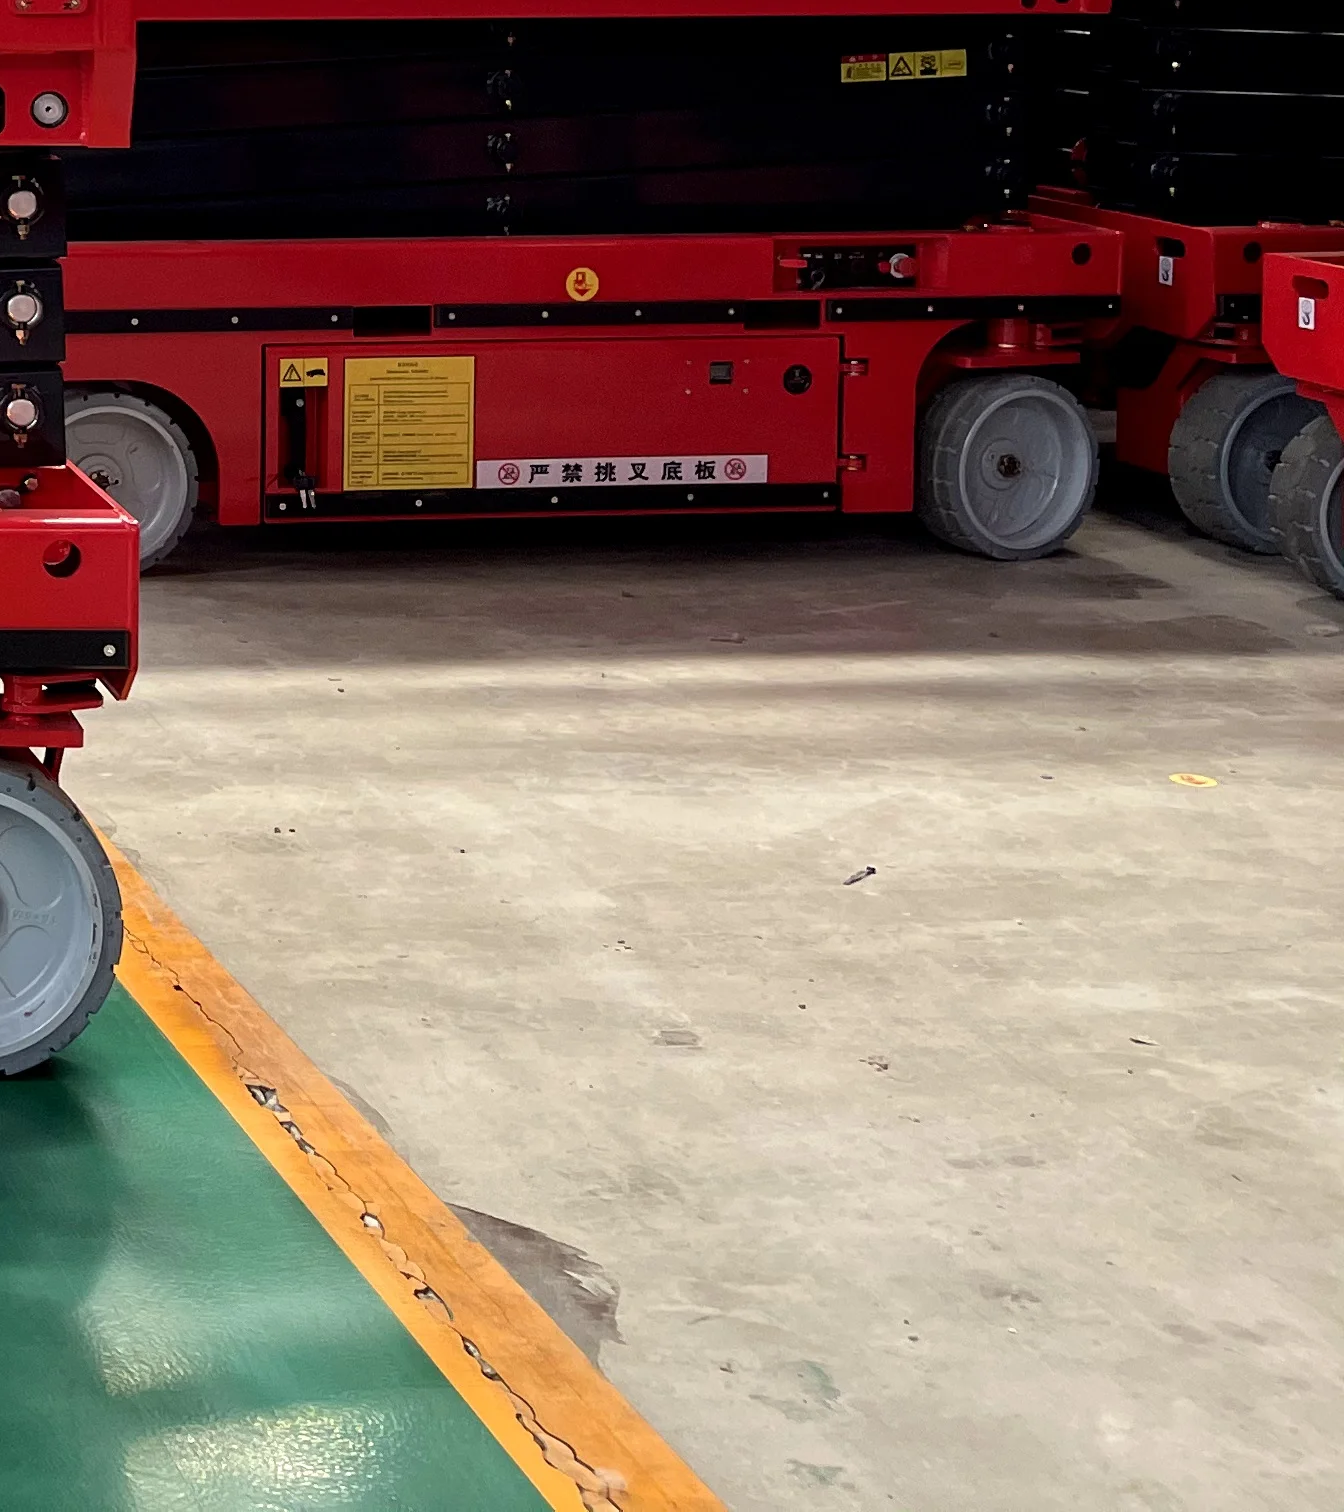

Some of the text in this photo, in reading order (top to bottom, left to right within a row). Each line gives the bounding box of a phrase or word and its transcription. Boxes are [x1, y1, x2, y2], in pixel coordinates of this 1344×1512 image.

[528, 460, 717, 484] 严禁挑叉底板
